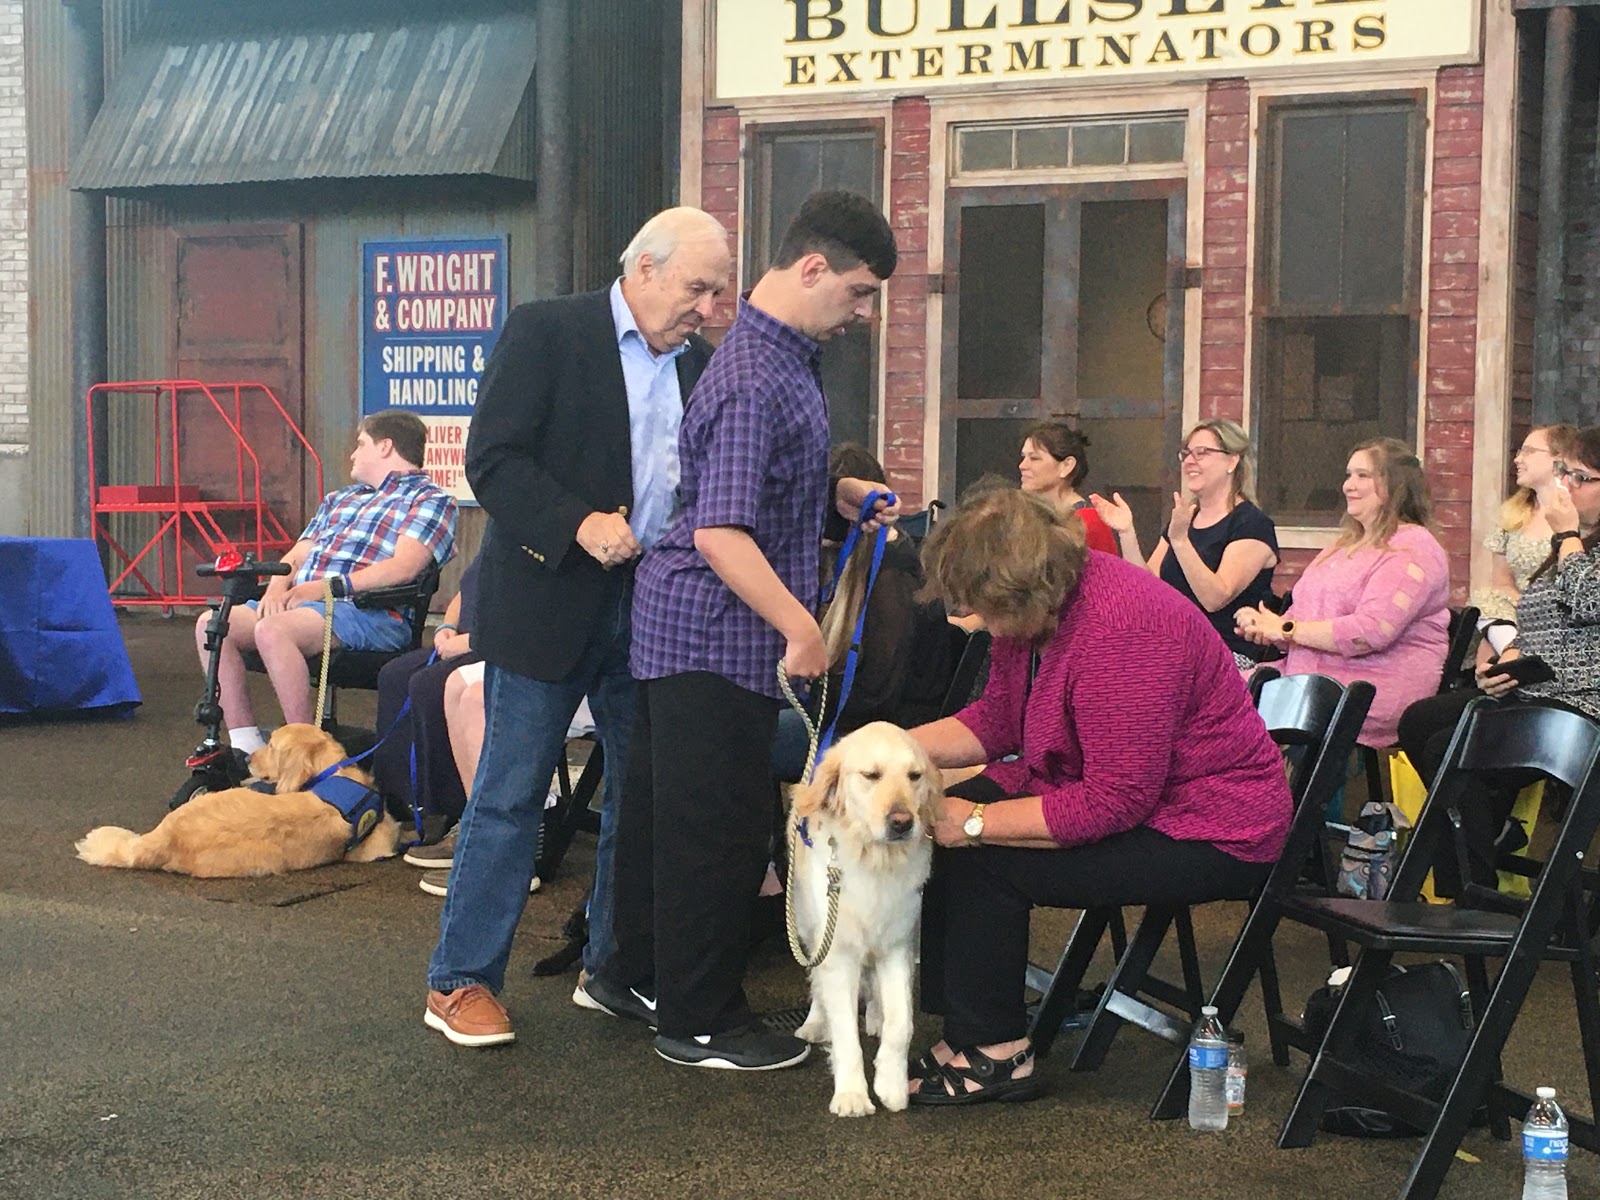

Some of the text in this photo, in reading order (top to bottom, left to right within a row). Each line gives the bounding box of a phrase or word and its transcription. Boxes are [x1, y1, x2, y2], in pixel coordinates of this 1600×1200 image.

[784, 14, 1387, 86] EXTERMINATORS
[151, 31, 375, 167] WRIGHT
[344, 27, 410, 160] &
[375, 252, 496, 293] F. WRIGHT
[374, 296, 497, 331] & COMPANY
[382, 344, 485, 373] SHIPPING &
[388, 378, 478, 406] HANDLING
[426, 426, 462, 444] LIVER
